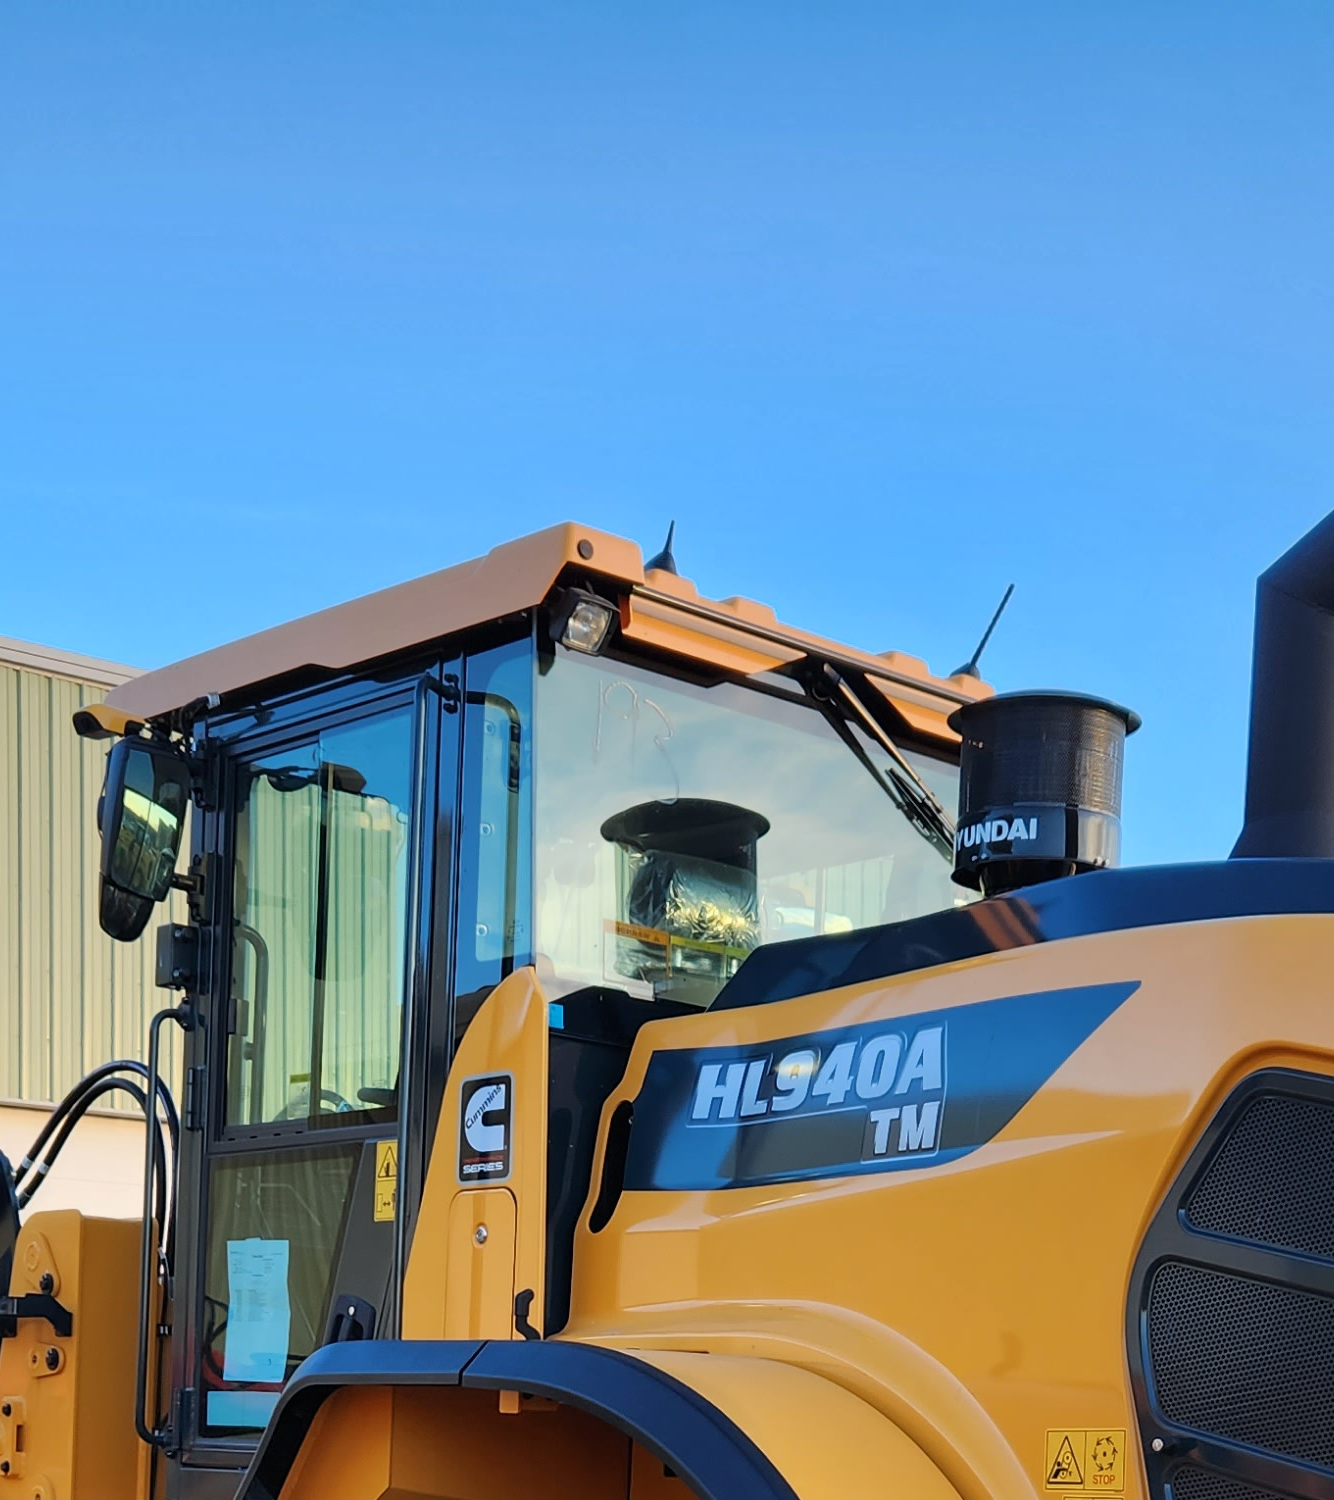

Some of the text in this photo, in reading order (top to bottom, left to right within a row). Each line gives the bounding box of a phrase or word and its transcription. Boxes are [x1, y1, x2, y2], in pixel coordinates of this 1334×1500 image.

[956, 817, 1038, 852] YUNDAI
[691, 1026, 944, 1121] HL940A
[465, 1084, 502, 1130] Cummins
[870, 1101, 942, 1155] TM
[462, 1161, 504, 1174] SERIES
[1092, 1474, 1115, 1485] STOP
